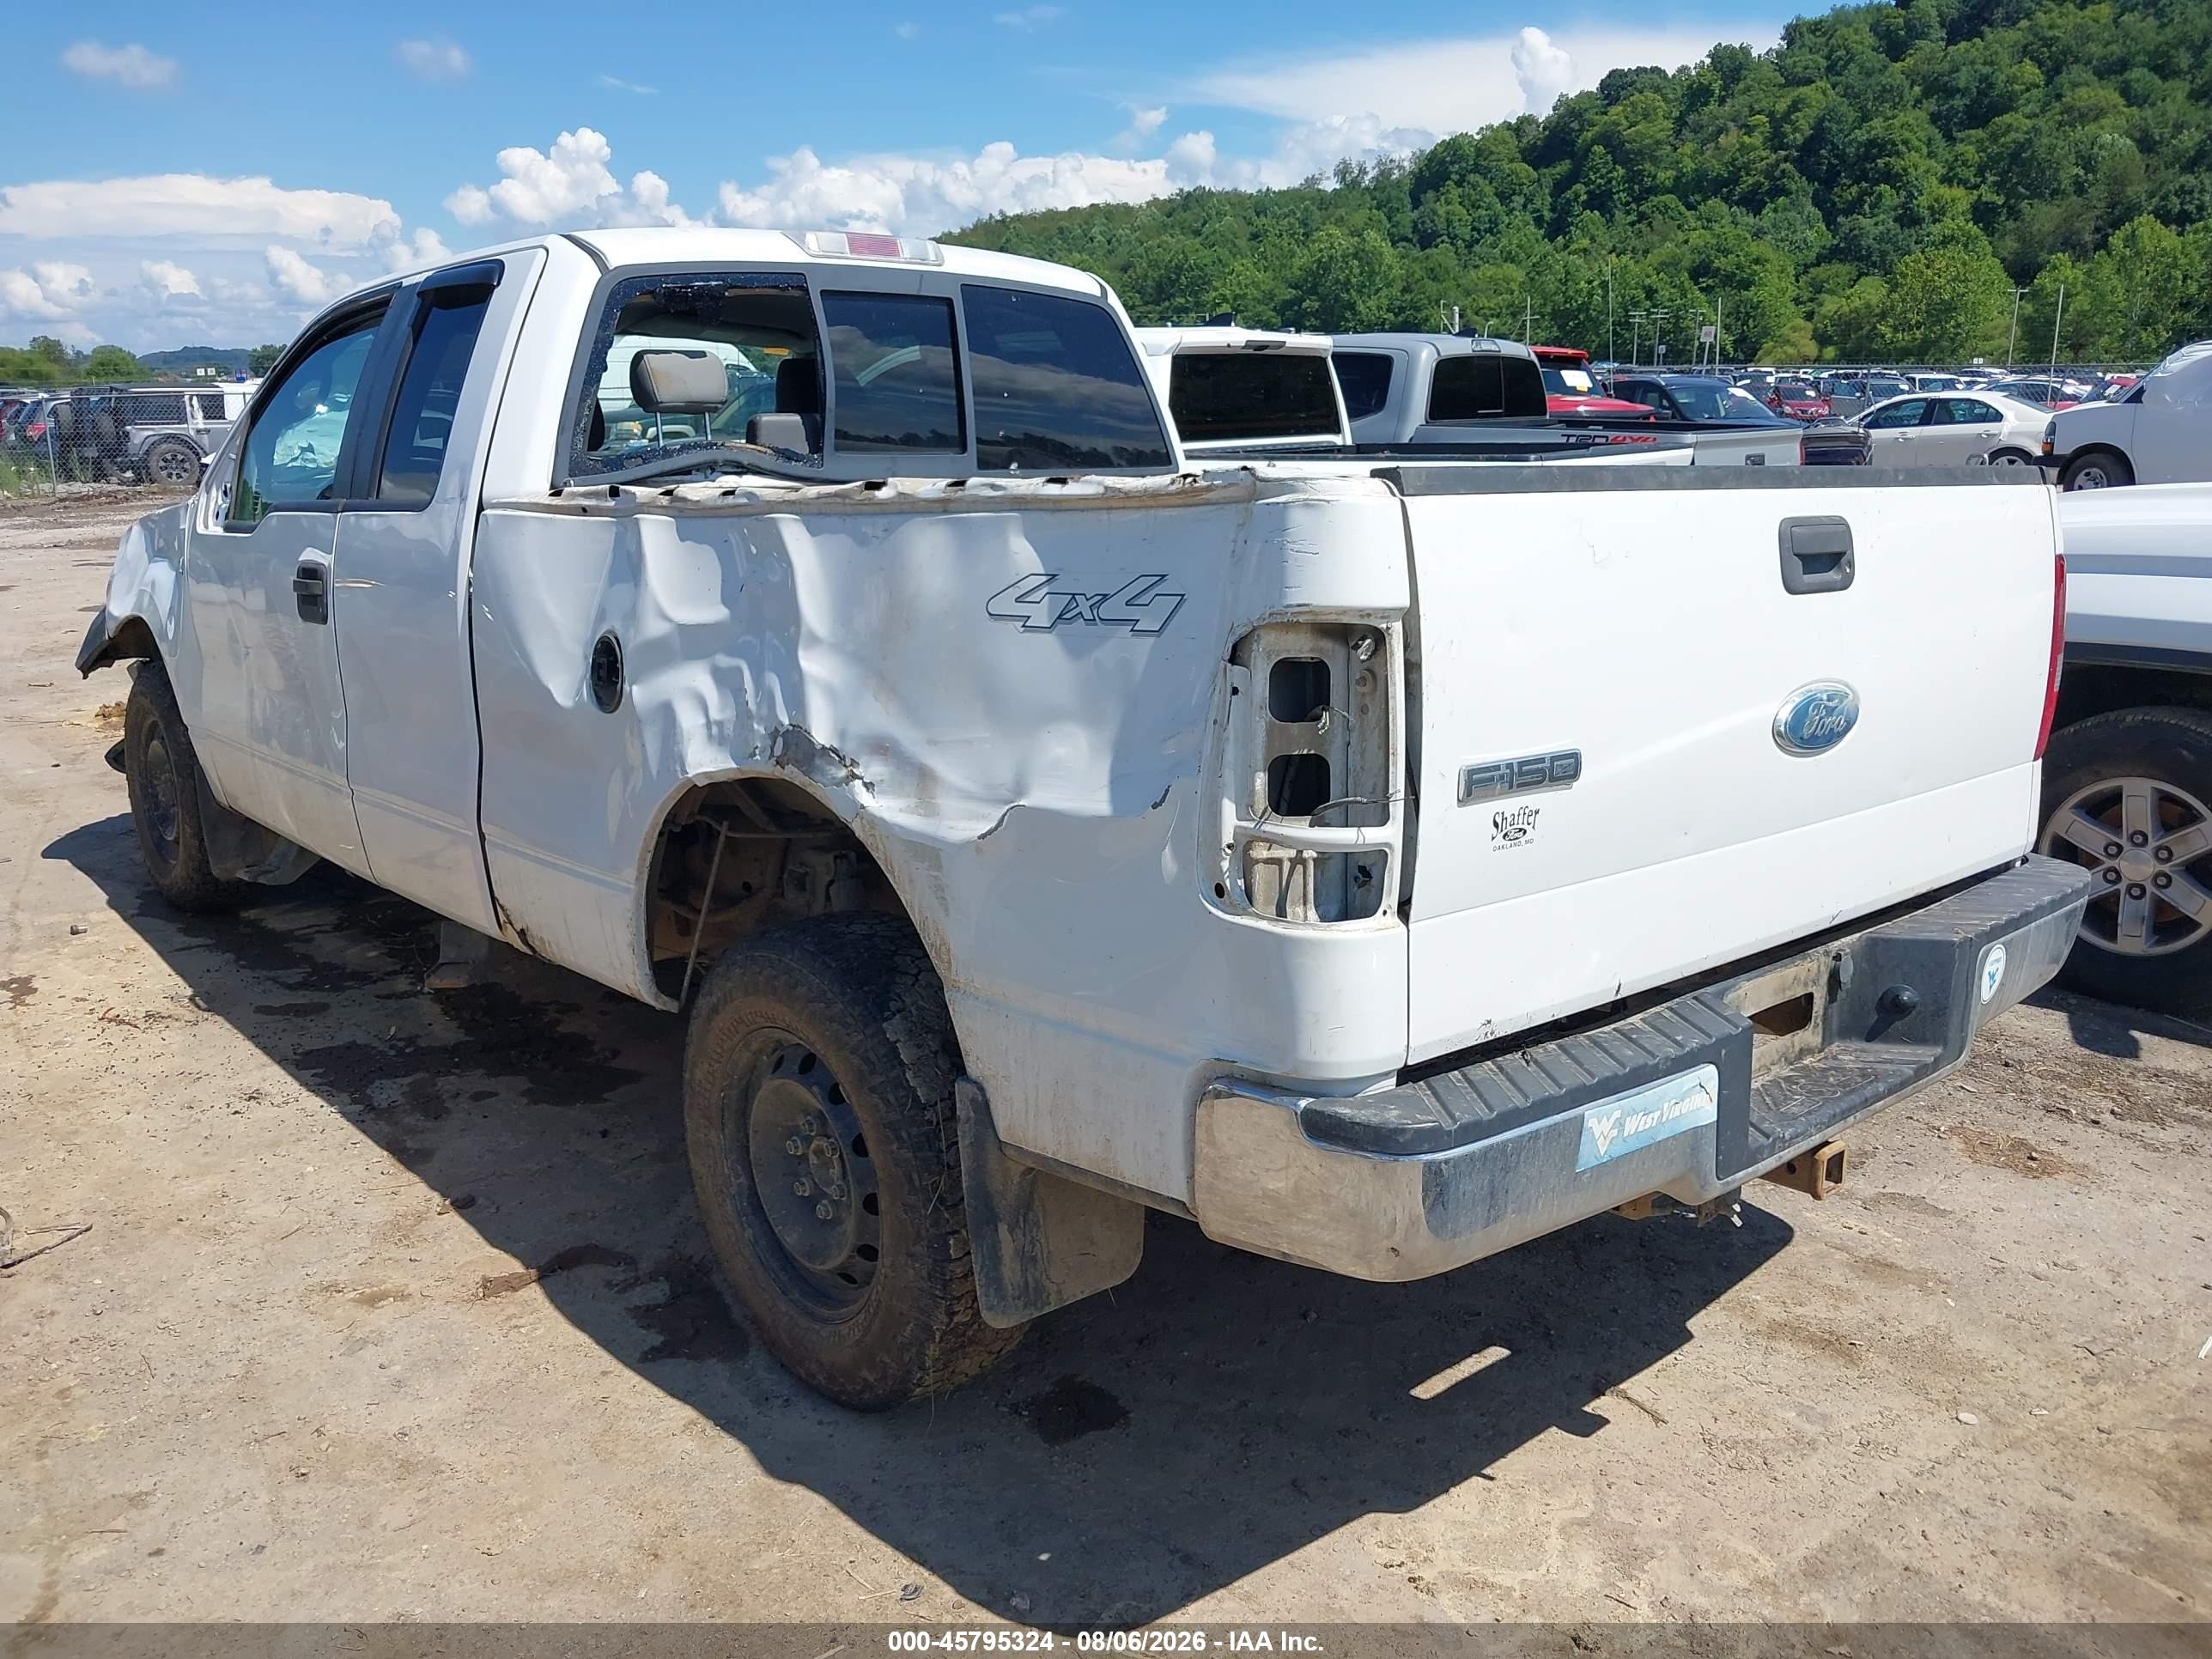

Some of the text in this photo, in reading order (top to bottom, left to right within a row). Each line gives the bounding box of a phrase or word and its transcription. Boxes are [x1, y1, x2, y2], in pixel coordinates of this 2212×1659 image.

[986, 573, 1187, 638] 4x4
[1803, 699, 1848, 739] Ford
[1492, 805, 1540, 842] Shaffer
[1492, 840, 1523, 852] OAKLAND,
